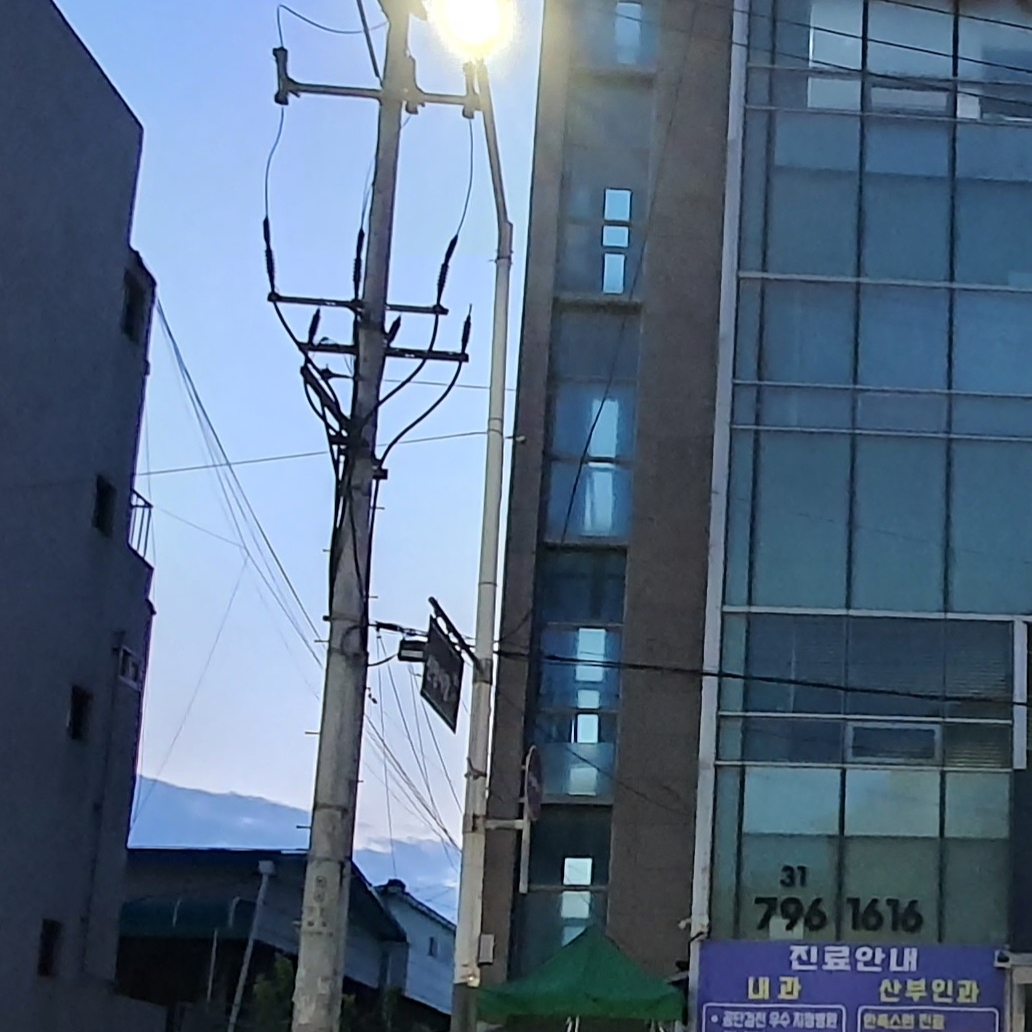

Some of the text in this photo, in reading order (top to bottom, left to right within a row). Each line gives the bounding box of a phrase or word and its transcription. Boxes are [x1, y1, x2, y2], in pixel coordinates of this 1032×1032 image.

[780, 865, 807, 887] 31
[754, 896, 924, 932] 796 1616
[789, 945, 918, 972] 진료안내
[879, 979, 980, 1003] 산부인과
